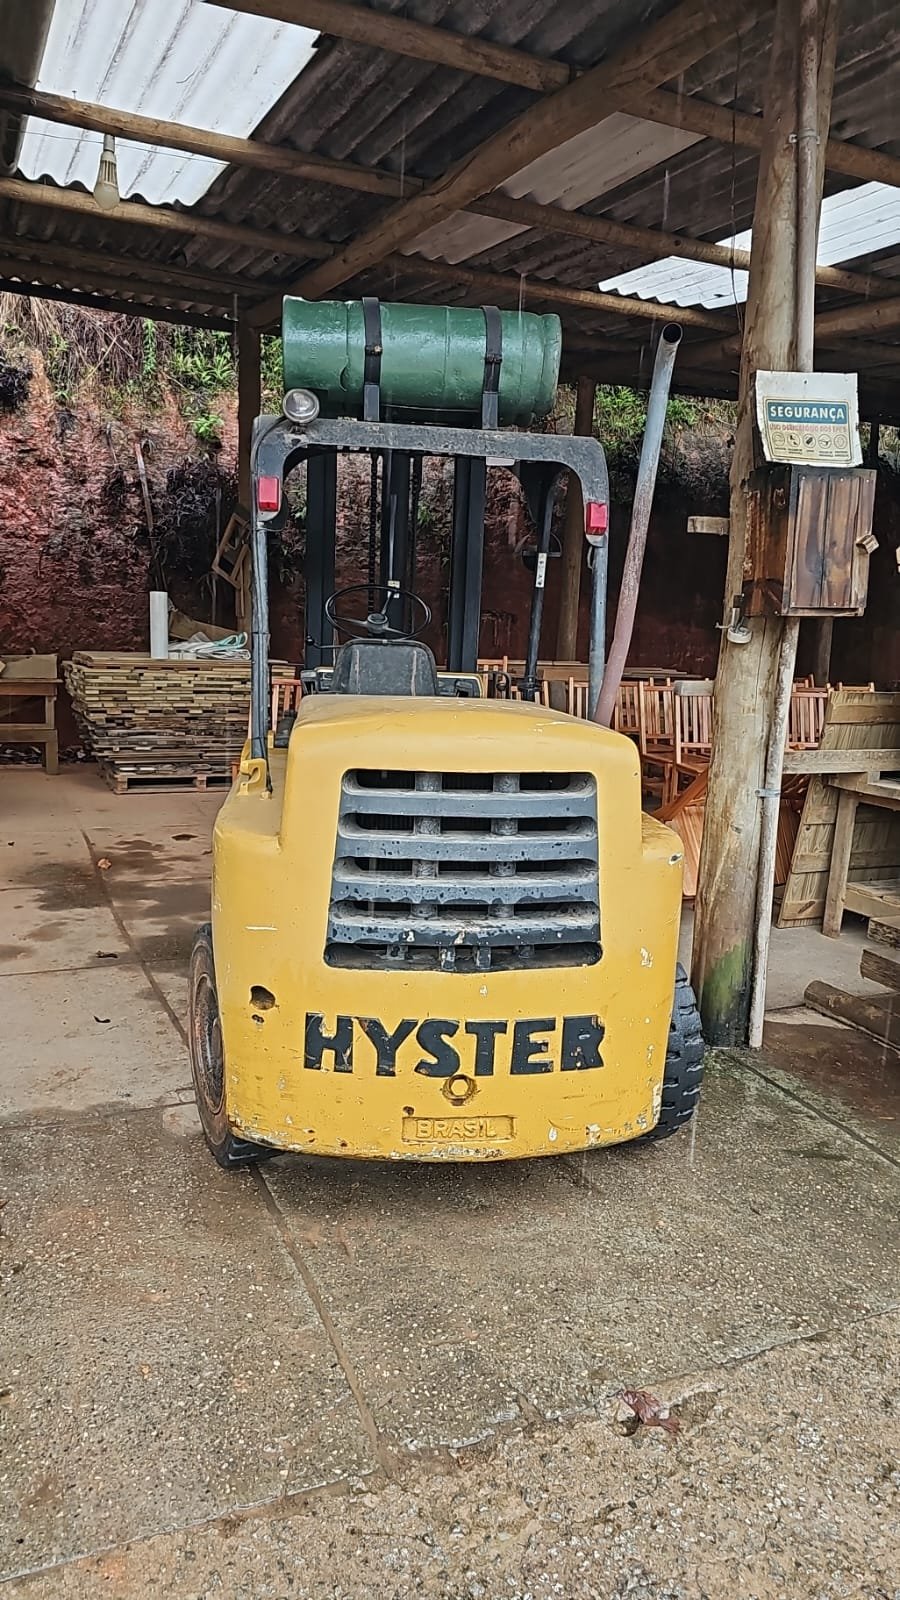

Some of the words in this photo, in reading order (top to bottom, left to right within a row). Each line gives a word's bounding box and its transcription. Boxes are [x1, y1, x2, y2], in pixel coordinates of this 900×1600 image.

[770, 405, 845, 422] SEGURANÇA
[303, 1012, 605, 1077] HYSTER
[415, 1119, 498, 1140] BRASIL
